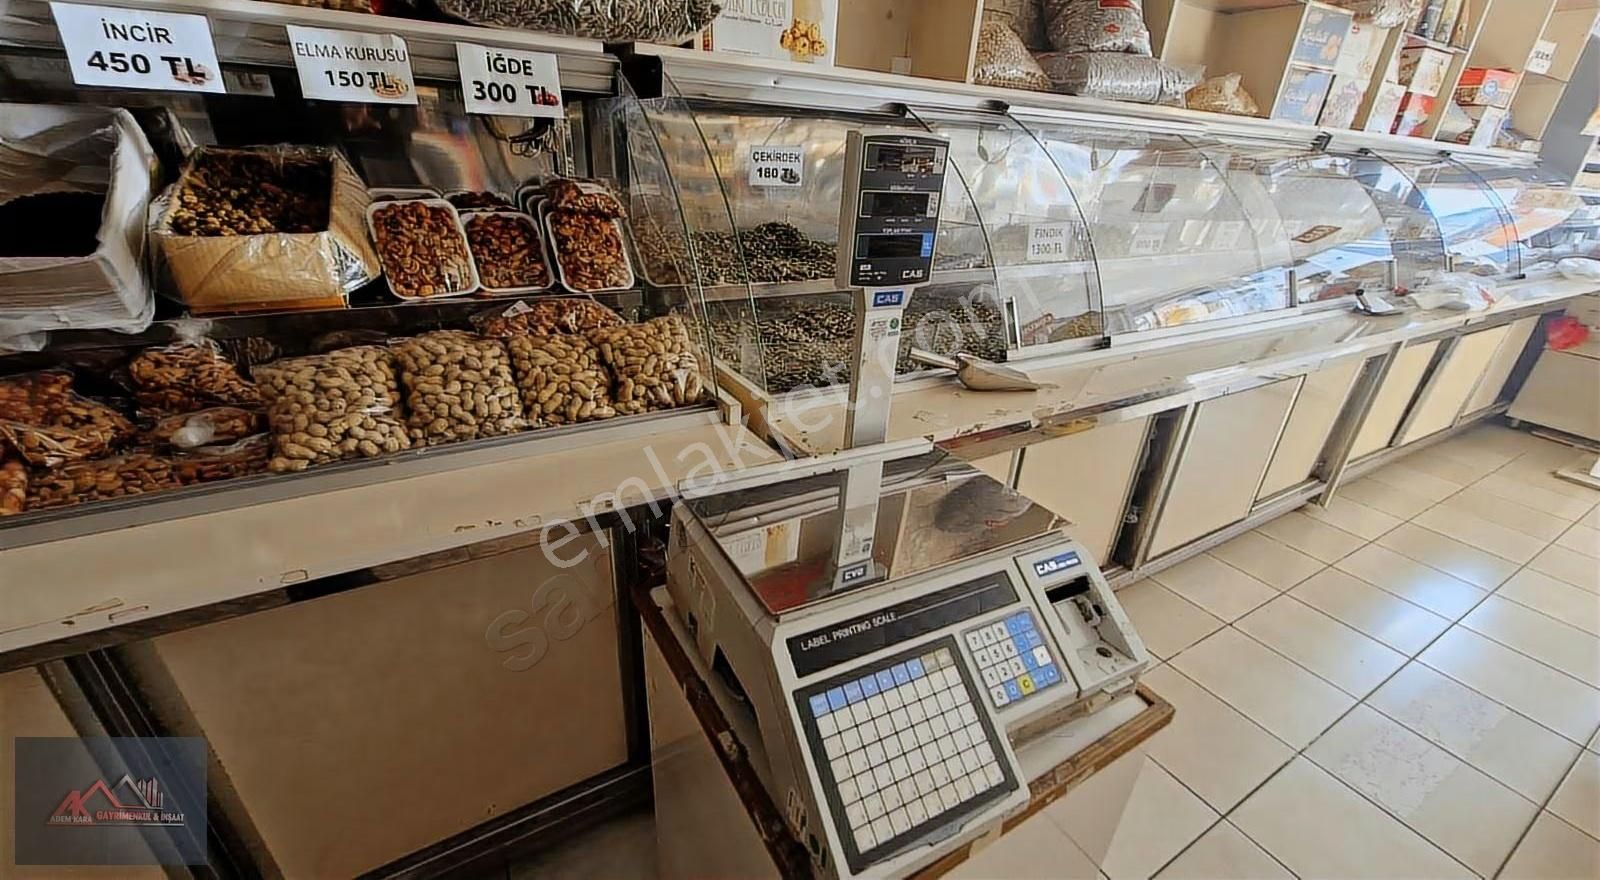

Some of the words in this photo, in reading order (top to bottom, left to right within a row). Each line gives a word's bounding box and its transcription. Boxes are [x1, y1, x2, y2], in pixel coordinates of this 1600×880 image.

[101, 18, 173, 44] İNCİR
[295, 42, 341, 59] ELMA
[344, 46, 406, 62] KURUSU
[87, 50, 151, 74] 450
[160, 55, 207, 80] TL
[486, 51, 533, 76] İĞDE
[325, 69, 364, 87] 150
[367, 71, 394, 89] TL
[472, 80, 517, 103] 300
[525, 84, 558, 106] TL
[752, 149, 801, 163] ÇEKİRDEK
[757, 166, 778, 179] 180
[781, 167, 797, 180] TL
[1034, 227, 1065, 240] FINDIK
[902, 269, 923, 279] CAS
[876, 293, 900, 304] CAS
[1036, 559, 1057, 575] CAS
[800, 633, 831, 651] LABEL
[832, 620, 872, 642] PRINTING
[872, 611, 897, 628] SCALE
